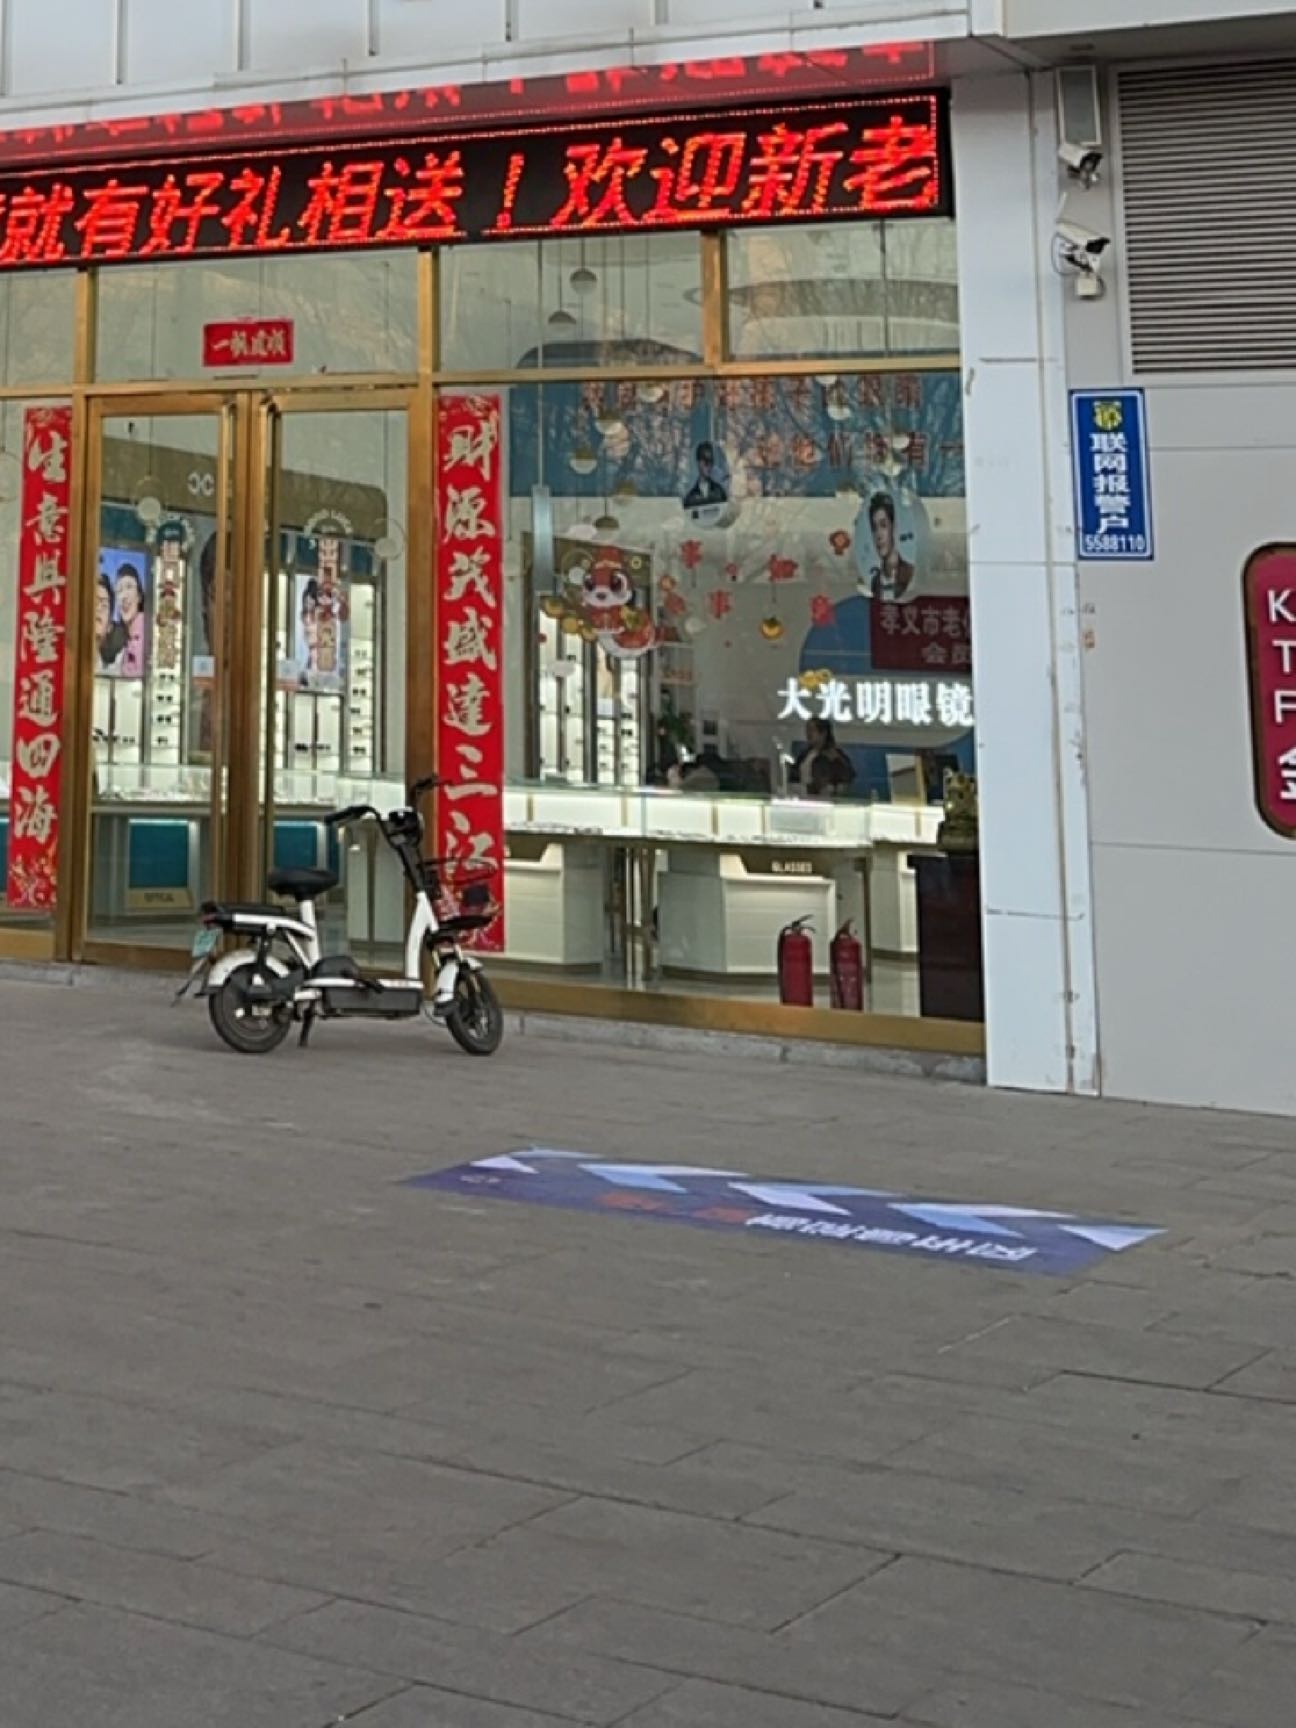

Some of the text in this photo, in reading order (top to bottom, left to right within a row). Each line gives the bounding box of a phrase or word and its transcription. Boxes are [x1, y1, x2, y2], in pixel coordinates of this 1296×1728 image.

[879, 605, 972, 638] 孝义市老
[777, 676, 974, 725] 大光明眼镜
